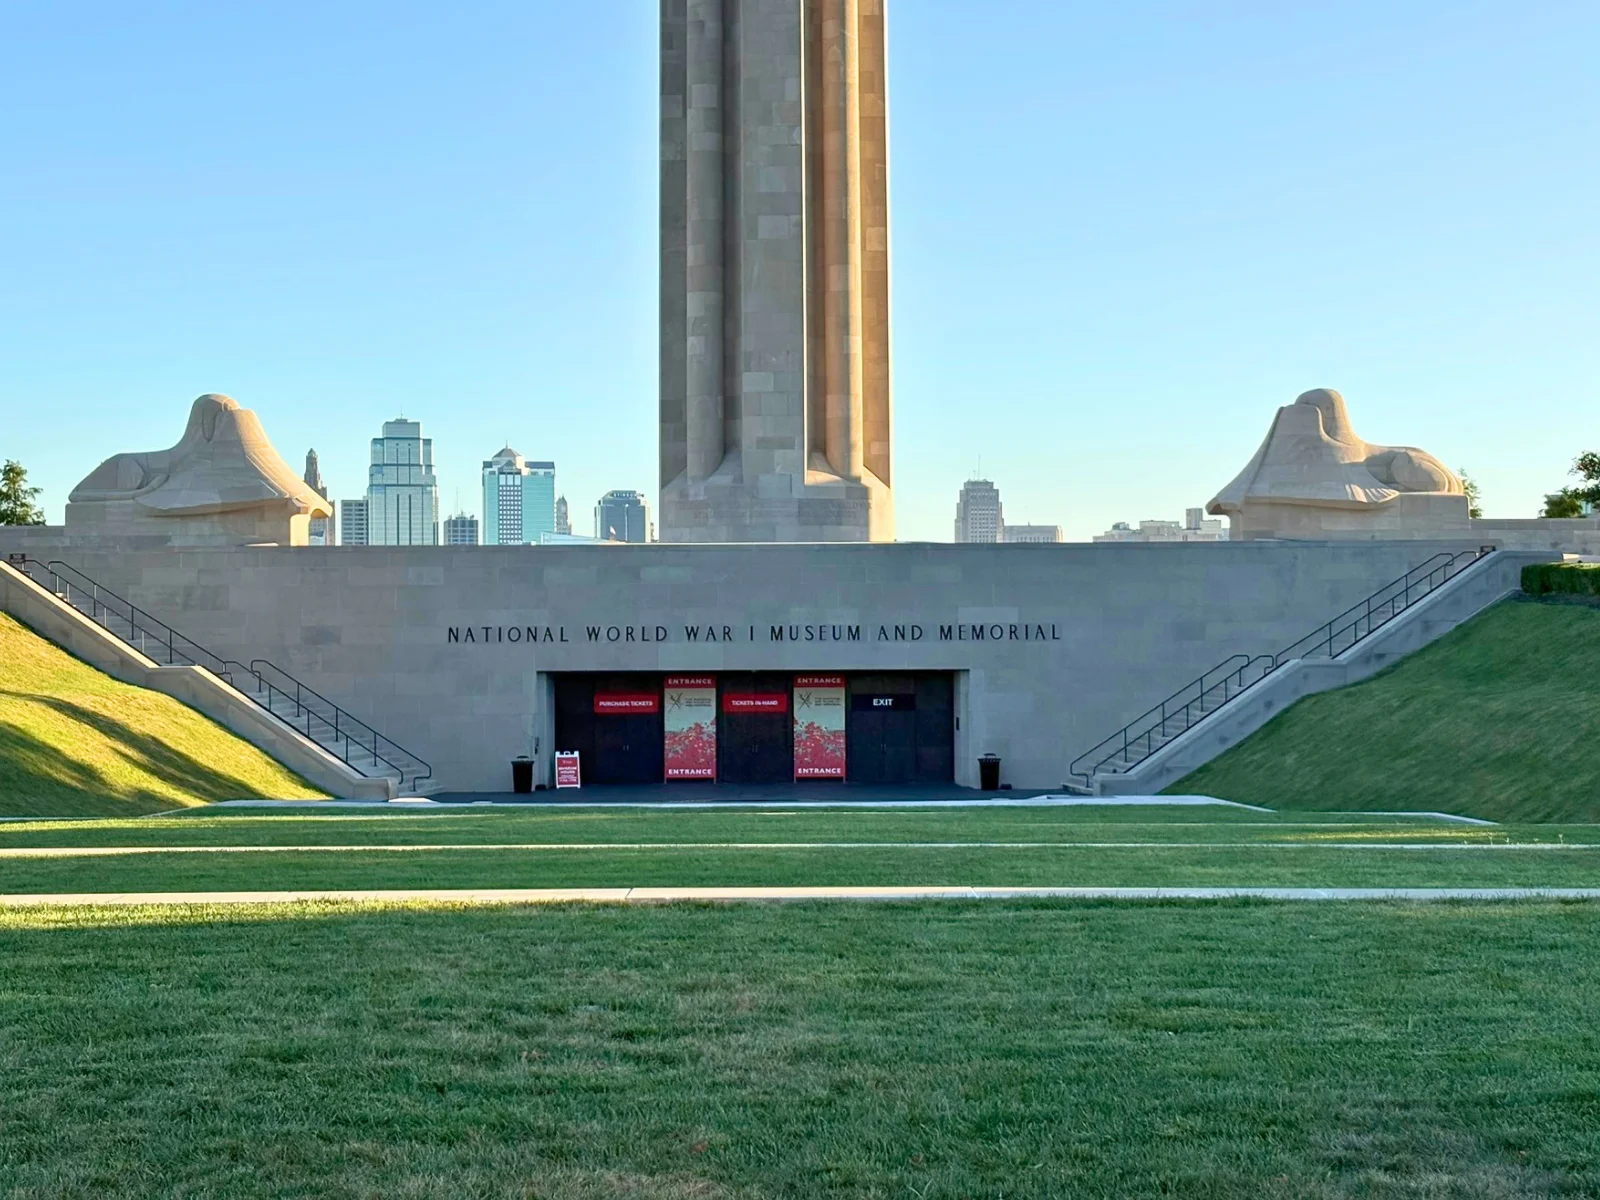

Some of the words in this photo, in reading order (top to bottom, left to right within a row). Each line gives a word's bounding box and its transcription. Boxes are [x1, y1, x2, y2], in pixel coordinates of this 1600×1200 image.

[447, 626, 570, 643] NATIONAL
[586, 625, 668, 642] WORLD
[685, 625, 733, 642] WAR
[749, 625, 754, 641] I
[770, 625, 861, 641] MUSEUM
[877, 624, 923, 641] AND
[939, 624, 1061, 640] MEMORIAL
[872, 698, 894, 706] EXIT
